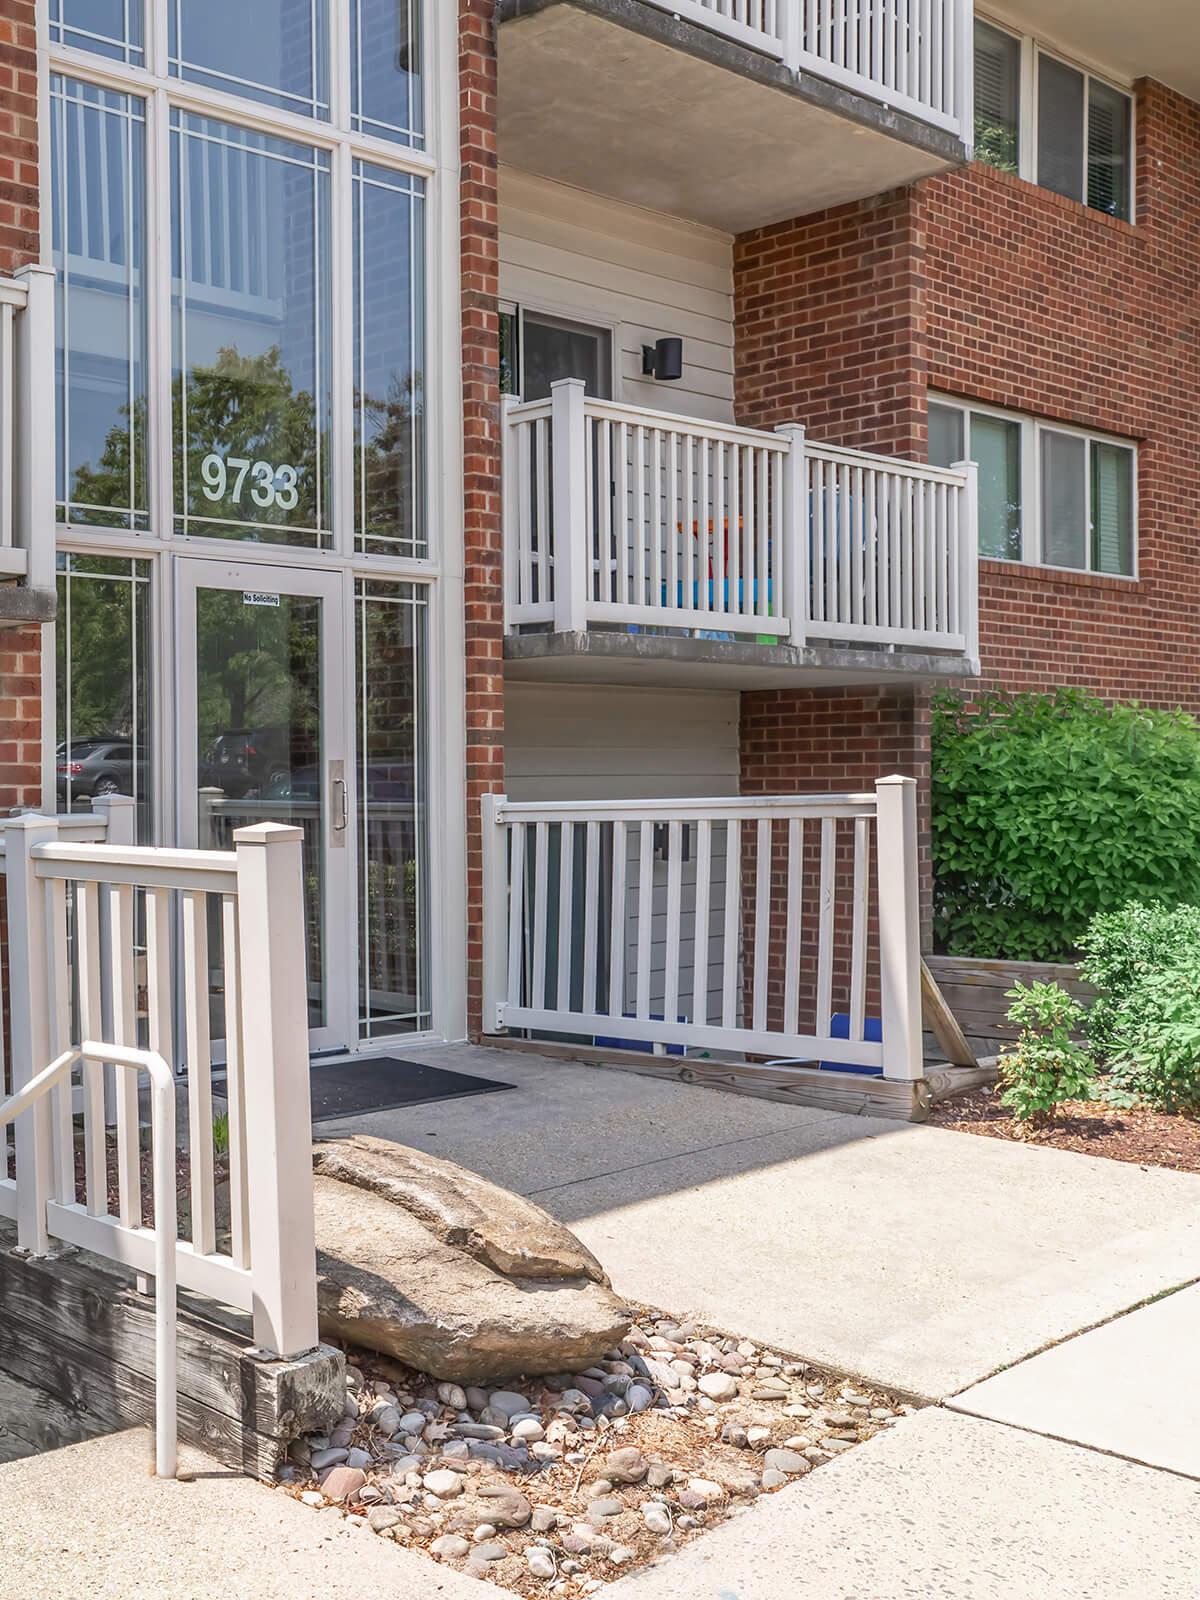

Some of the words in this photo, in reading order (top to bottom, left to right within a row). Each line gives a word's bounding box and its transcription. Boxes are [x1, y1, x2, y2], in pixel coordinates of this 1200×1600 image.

[201, 453, 299, 511] 9733
[244, 593, 252, 602] No
[253, 593, 278, 605] Soliciting
